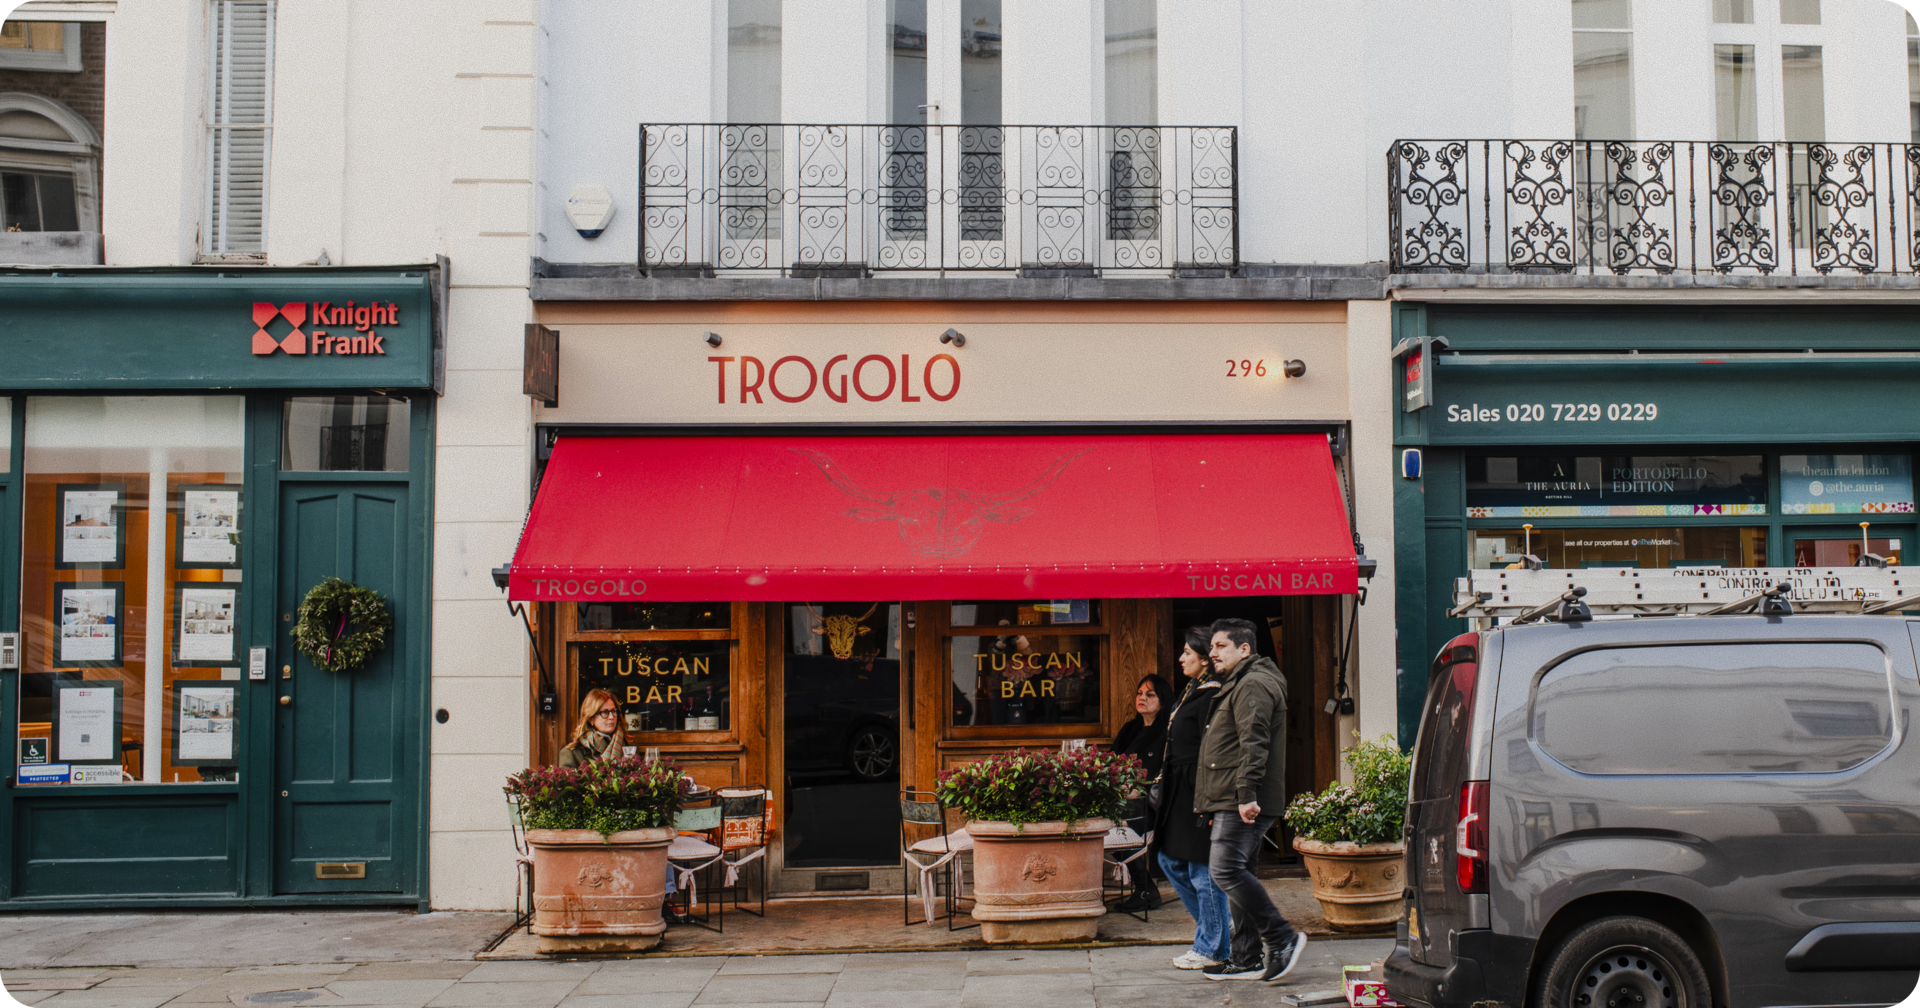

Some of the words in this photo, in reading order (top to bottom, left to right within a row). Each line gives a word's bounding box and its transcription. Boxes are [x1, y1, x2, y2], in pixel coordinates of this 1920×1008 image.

[313, 301, 399, 331] Knight
[312, 331, 385, 354] Frank
[1225, 359, 1267, 377] 296
[707, 353, 961, 404] TROGOLO
[1447, 403, 1500, 422] Sales
[1506, 404, 1545, 422] 020
[1551, 404, 1601, 422] 7229
[1607, 403, 1658, 421] 0229
[1612, 467, 1708, 480] PORTOBELLO
[1802, 464, 1890, 476] theauria.london
[1525, 481, 1548, 491] THE
[1553, 481, 1591, 491] AURIA
[1612, 480, 1675, 493] EDITION
[1825, 481, 1885, 494] @the.auria
[531, 579, 647, 596] TROGOLO
[1187, 574, 1283, 591] TUSCAN
[1291, 573, 1335, 589] BAR
[598, 657, 710, 676] TUSCAN
[973, 651, 1081, 672] TUSCAN
[626, 685, 682, 704] BAR
[1001, 679, 1056, 699] BAR
[85, 769, 121, 777] accessible
